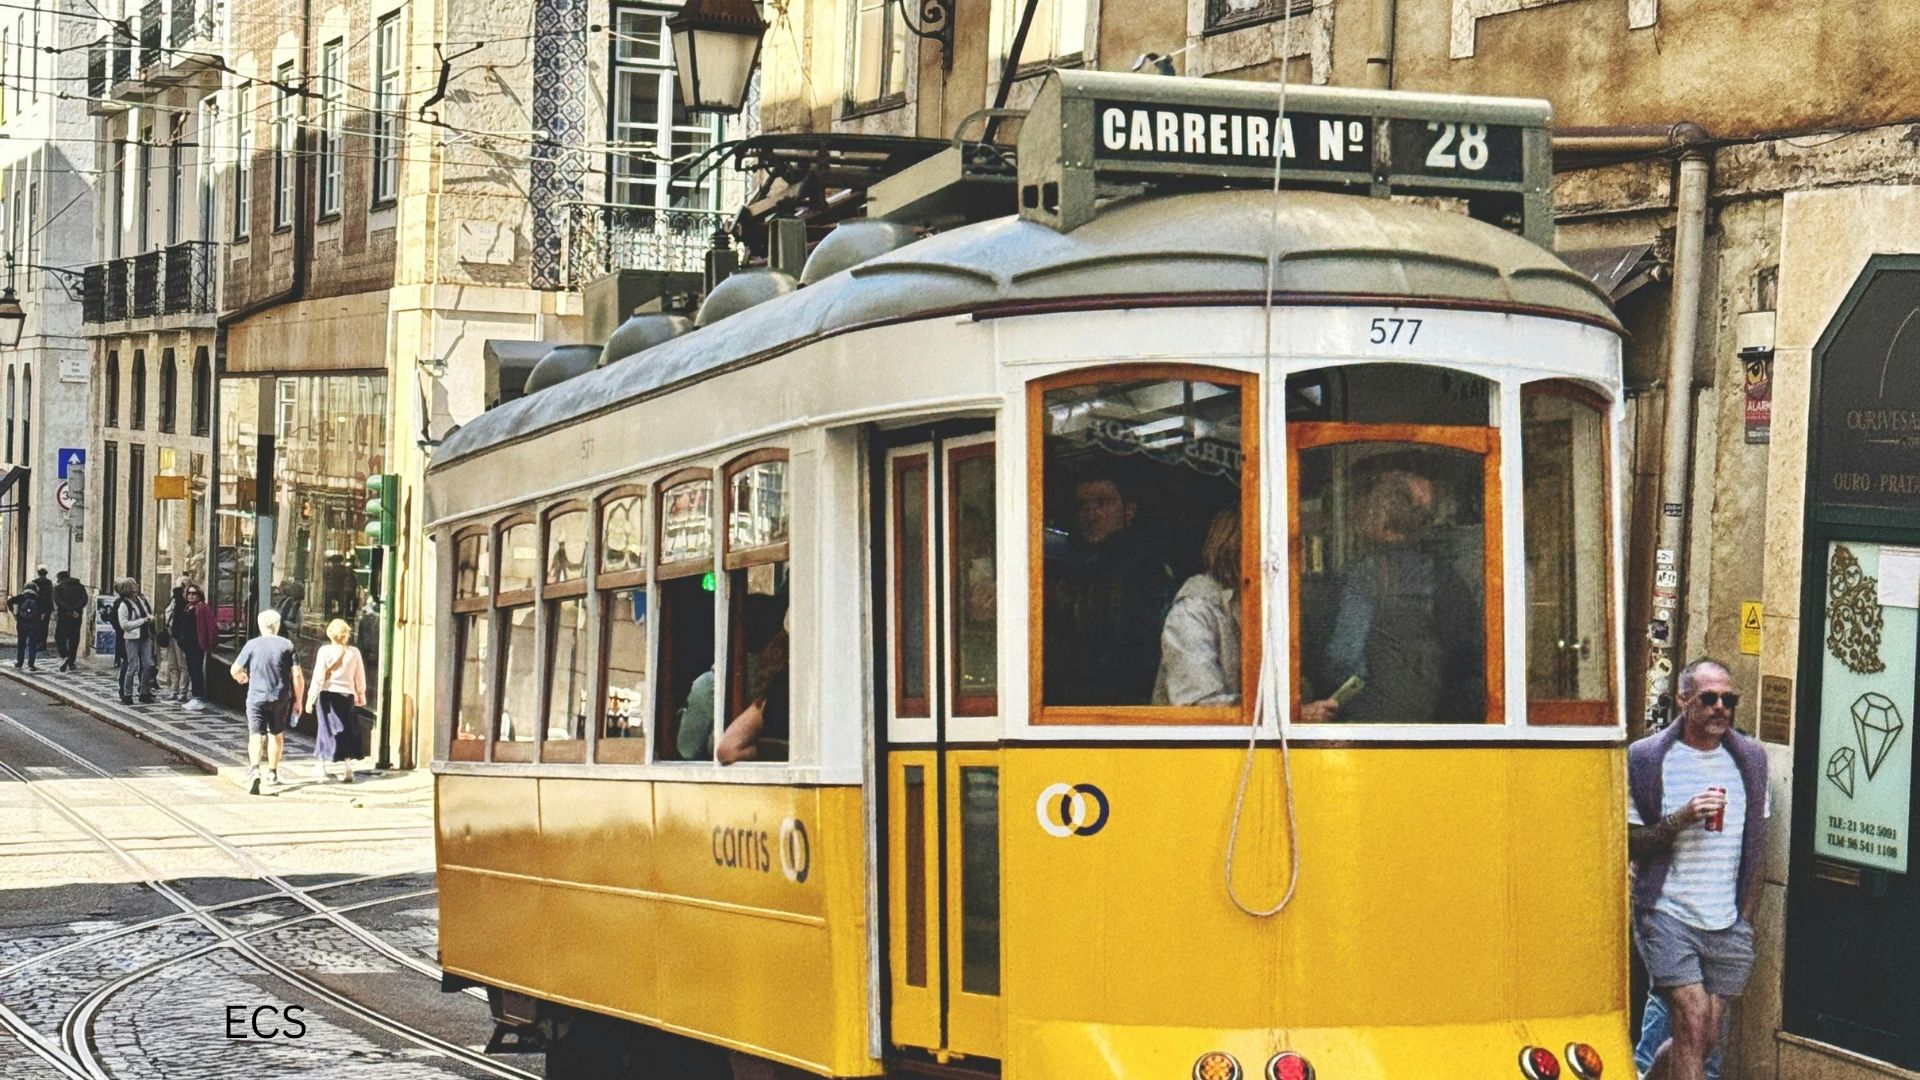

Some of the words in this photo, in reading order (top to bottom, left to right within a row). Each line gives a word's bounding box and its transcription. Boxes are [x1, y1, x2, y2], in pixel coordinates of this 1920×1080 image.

[1102, 107, 1296, 158] CARREIRA
[1425, 122, 1489, 170] 28
[1370, 318, 1423, 344] 577
[1834, 472, 1871, 491] OURO
[713, 812, 770, 873] carris
[1847, 819, 1857, 832] 21
[1860, 822, 1875, 836] 342
